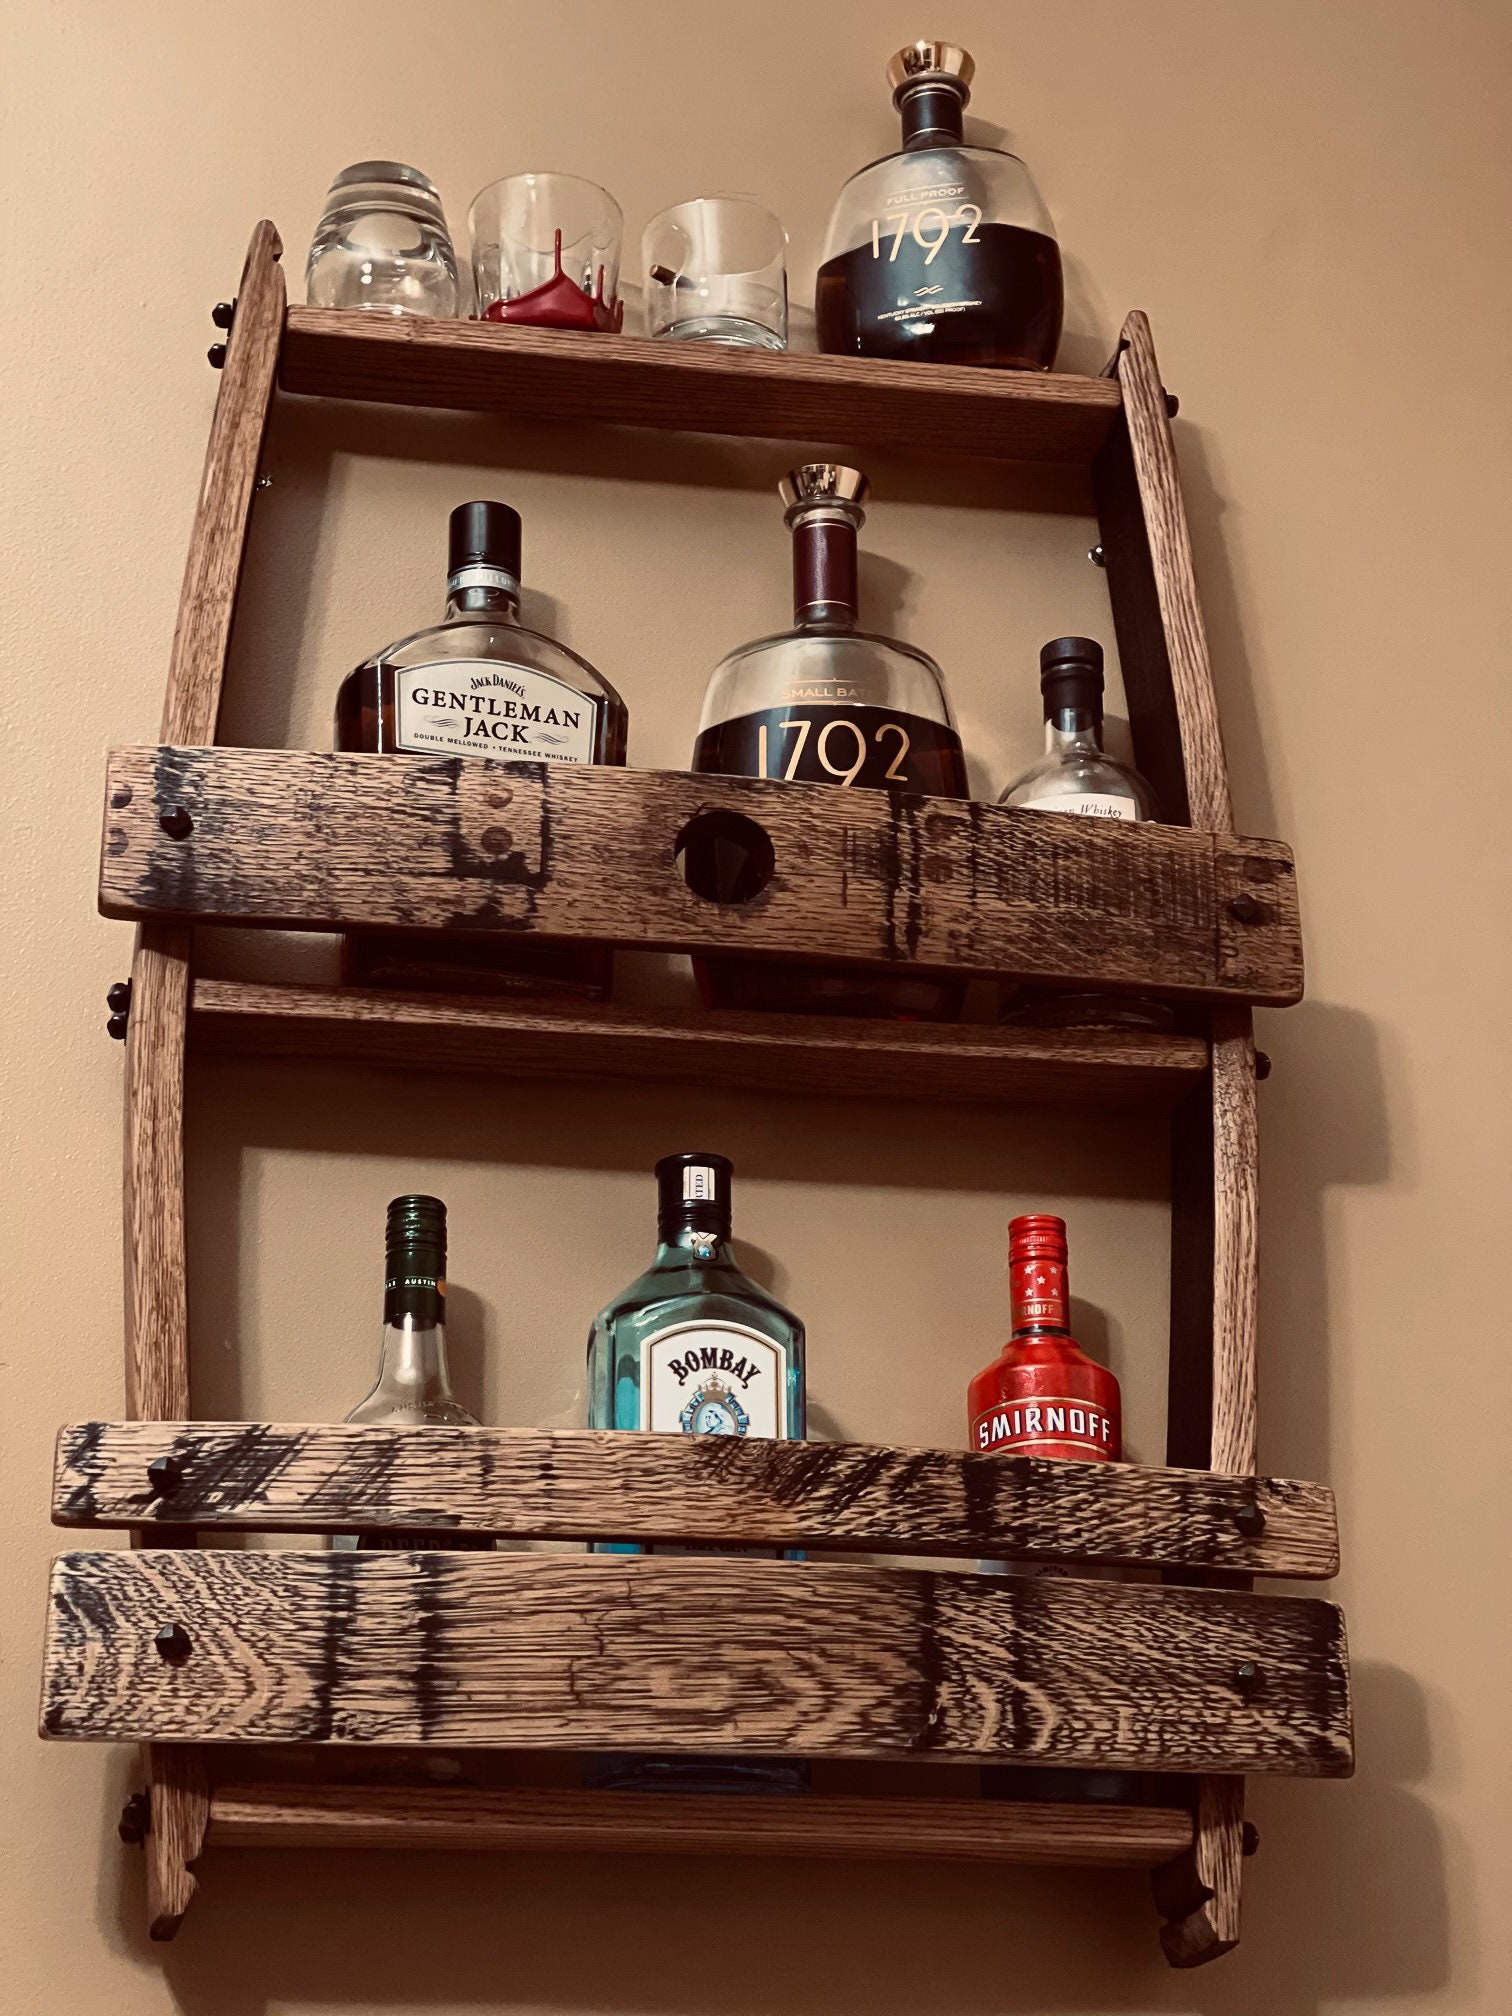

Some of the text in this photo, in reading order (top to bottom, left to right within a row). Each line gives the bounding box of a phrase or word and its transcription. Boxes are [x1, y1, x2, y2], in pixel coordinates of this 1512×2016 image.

[887, 186, 965, 206] FULL PROOF
[871, 203, 983, 265] 1792
[470, 676, 492, 691] JACK
[781, 687, 833, 699] SMALL
[411, 687, 581, 729] GENTLEMAN
[463, 716, 530, 744] JACK
[413, 732, 578, 763] DOUBLE MELLOWED TENNESSEE WHISKEY
[758, 720, 911, 787] 1792
[1080, 803, 1122, 819] Whiskey
[404, 1278, 436, 1288] AUSTIN
[667, 1347, 762, 1390] BOMBAY
[979, 1407, 1111, 1449] SMIRNOFF
